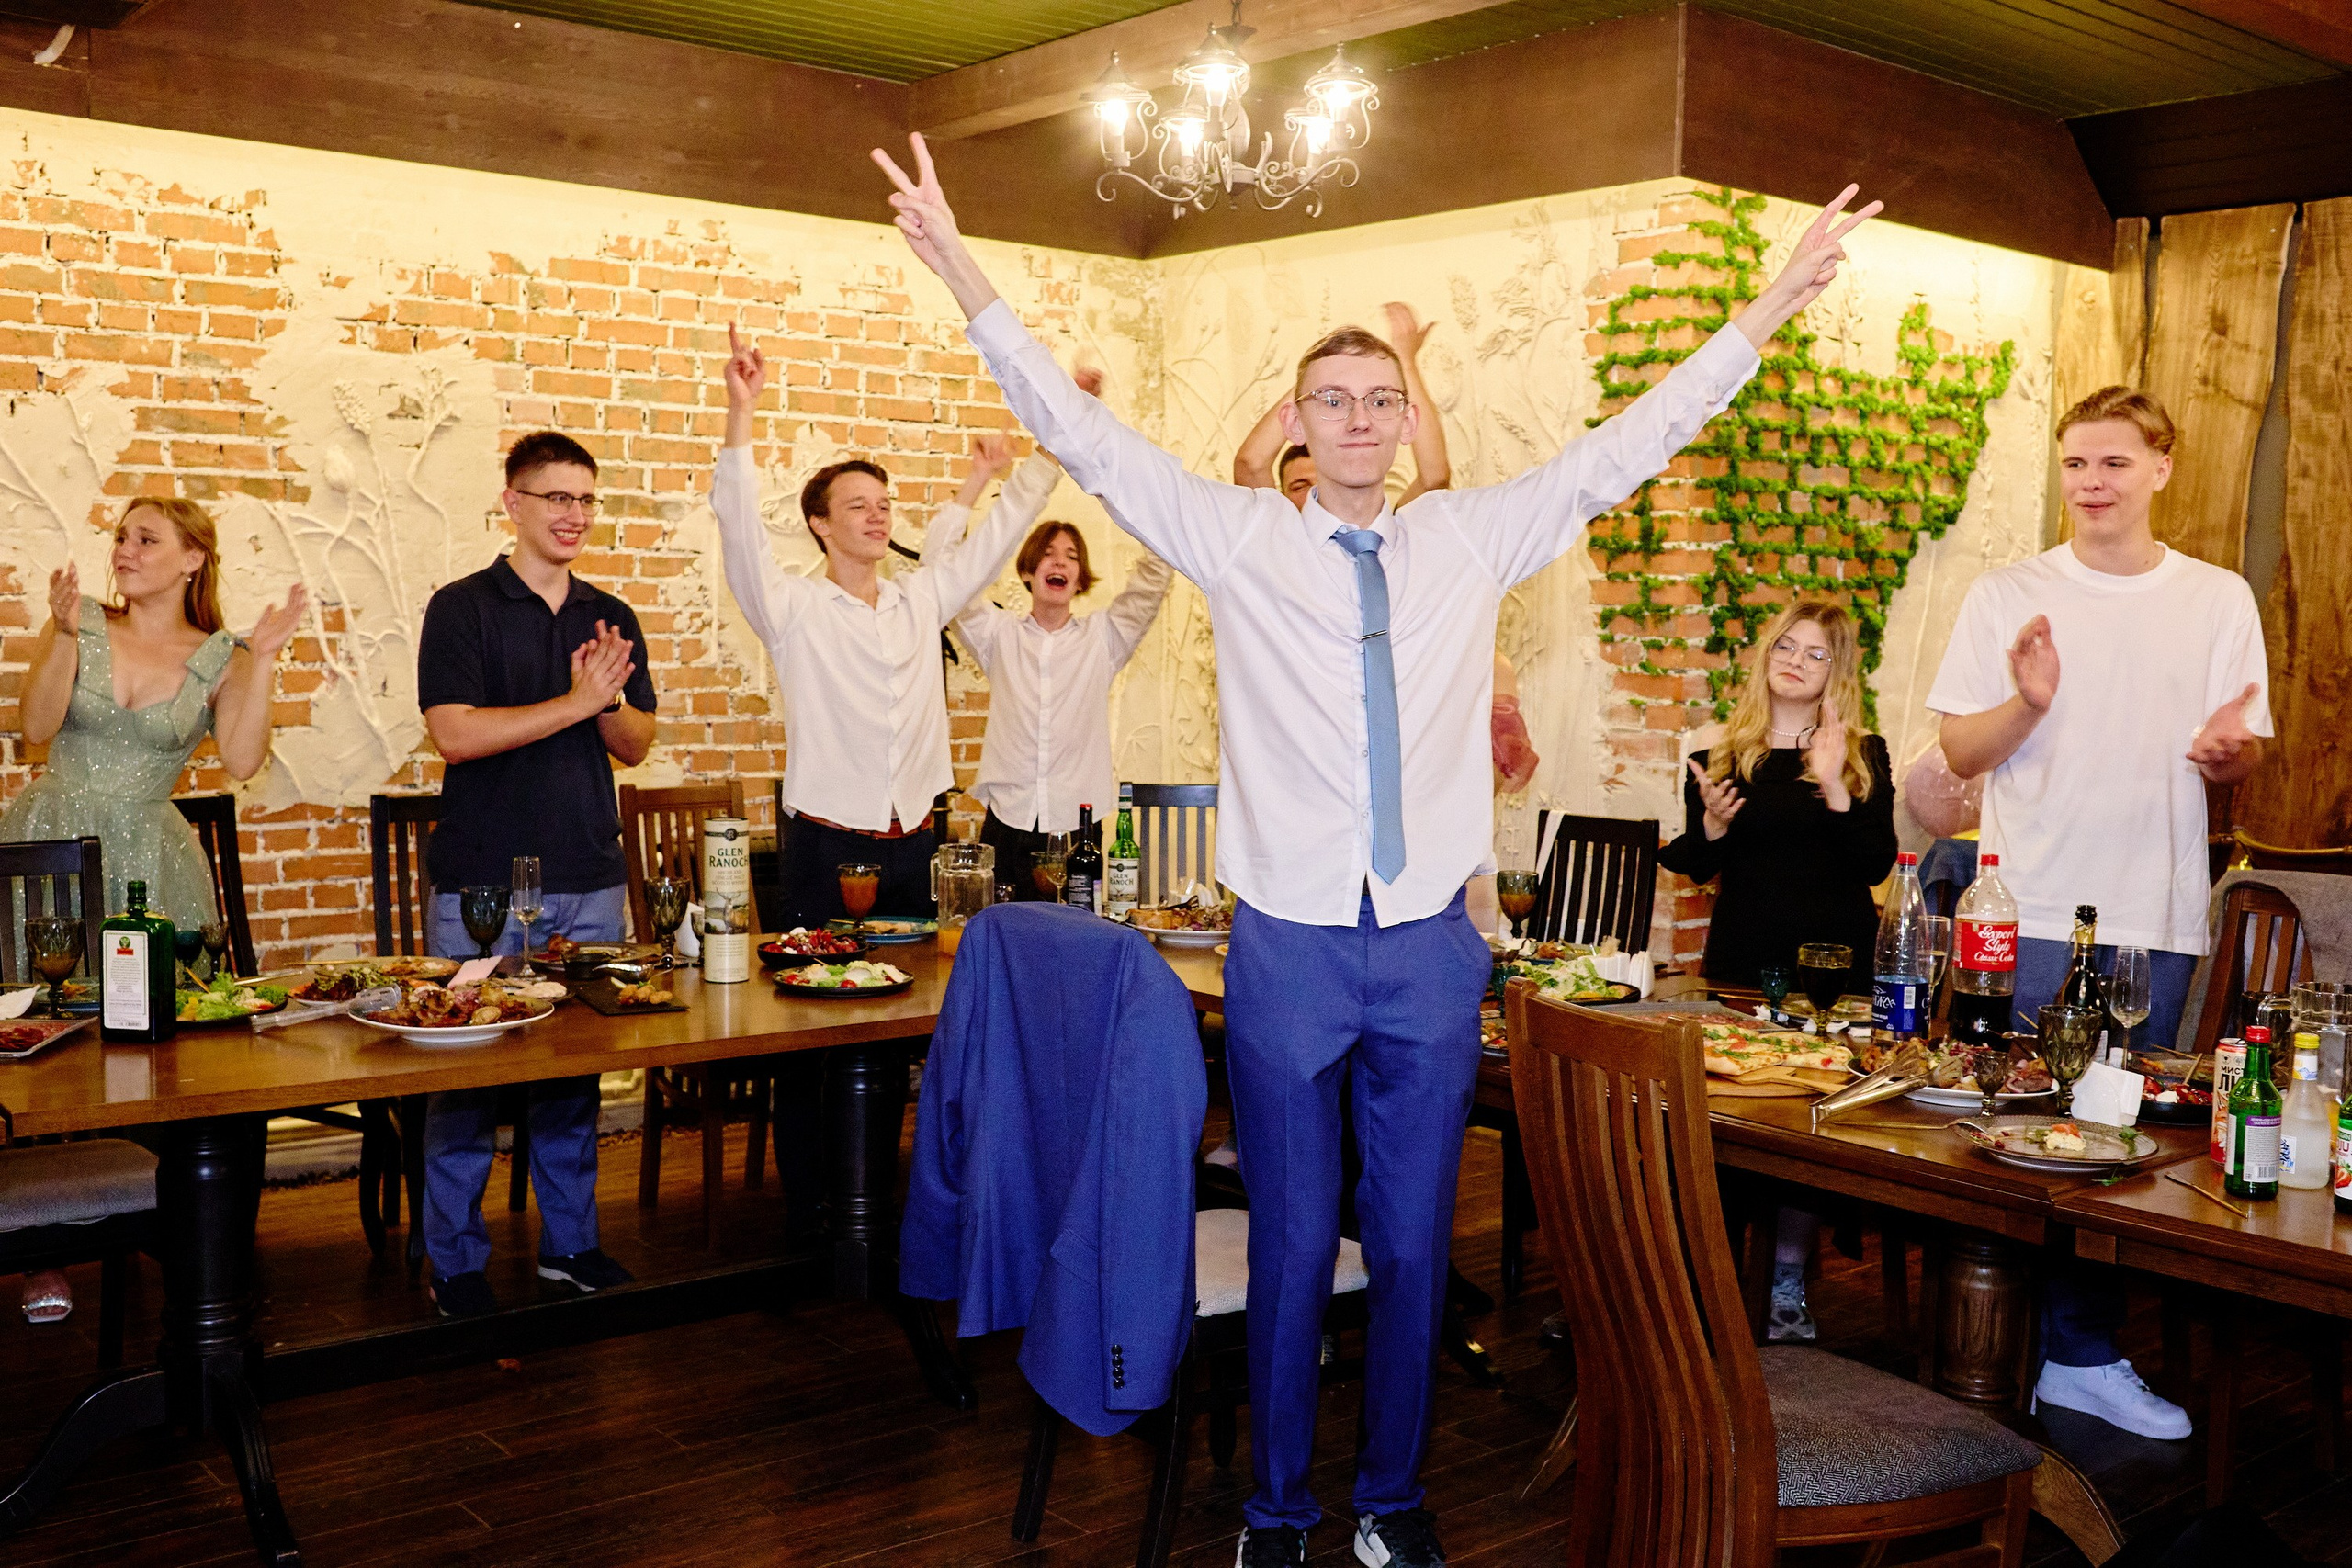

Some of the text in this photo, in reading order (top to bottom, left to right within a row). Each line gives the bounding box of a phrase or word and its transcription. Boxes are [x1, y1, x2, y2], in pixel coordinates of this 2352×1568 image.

[717, 847, 743, 857] GLEN
[1978, 925, 2017, 940] Export
[1983, 937, 2011, 955] Style
[1973, 951, 2015, 962] Classic Cola
